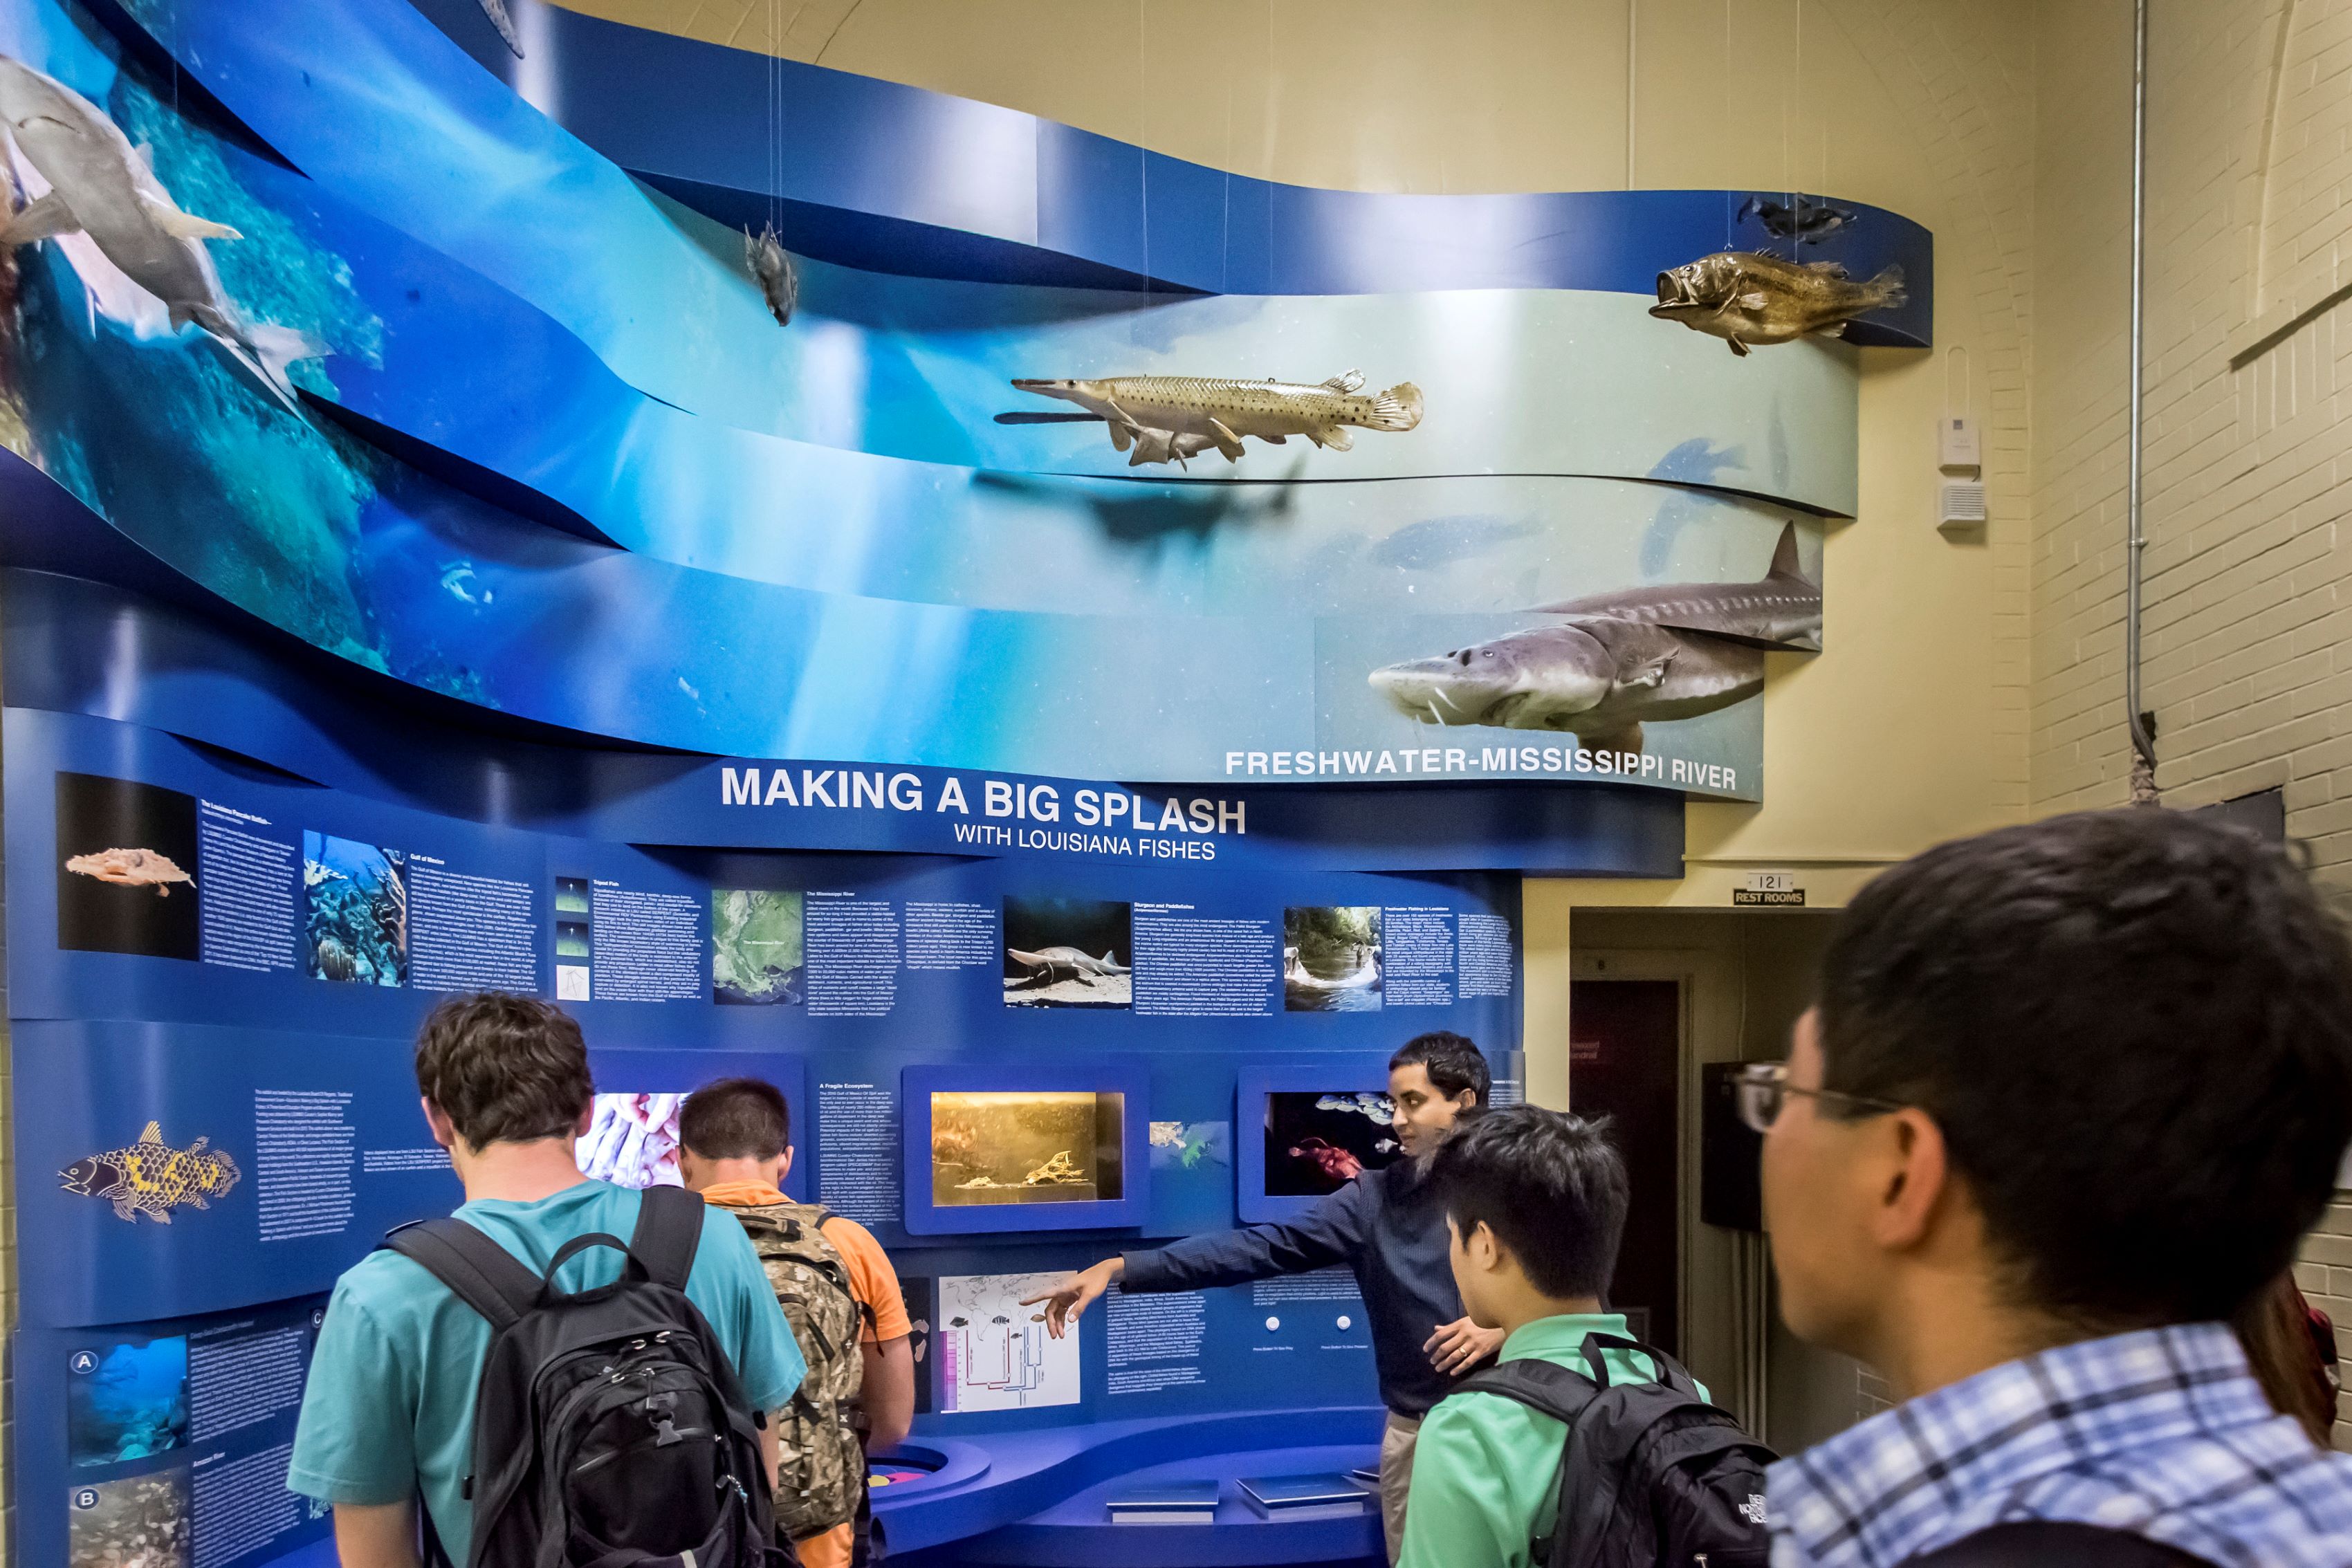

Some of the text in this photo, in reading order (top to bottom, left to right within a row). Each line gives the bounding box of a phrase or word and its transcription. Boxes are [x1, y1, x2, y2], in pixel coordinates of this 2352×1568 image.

[1225, 748, 1736, 790] FRESHWATER-MISSISSIPPI RIVER
[722, 768, 1245, 834] MAKING A BIG SPLASH
[954, 824, 1215, 860] WITH LOUISIANA FISHES
[427, 857, 445, 865] Mexico
[1760, 876, 1781, 889] 121
[1736, 893, 1803, 902] REST ROOMS
[314, 1313, 322, 1324] C
[78, 1355, 92, 1368] A
[82, 1492, 94, 1505] B
